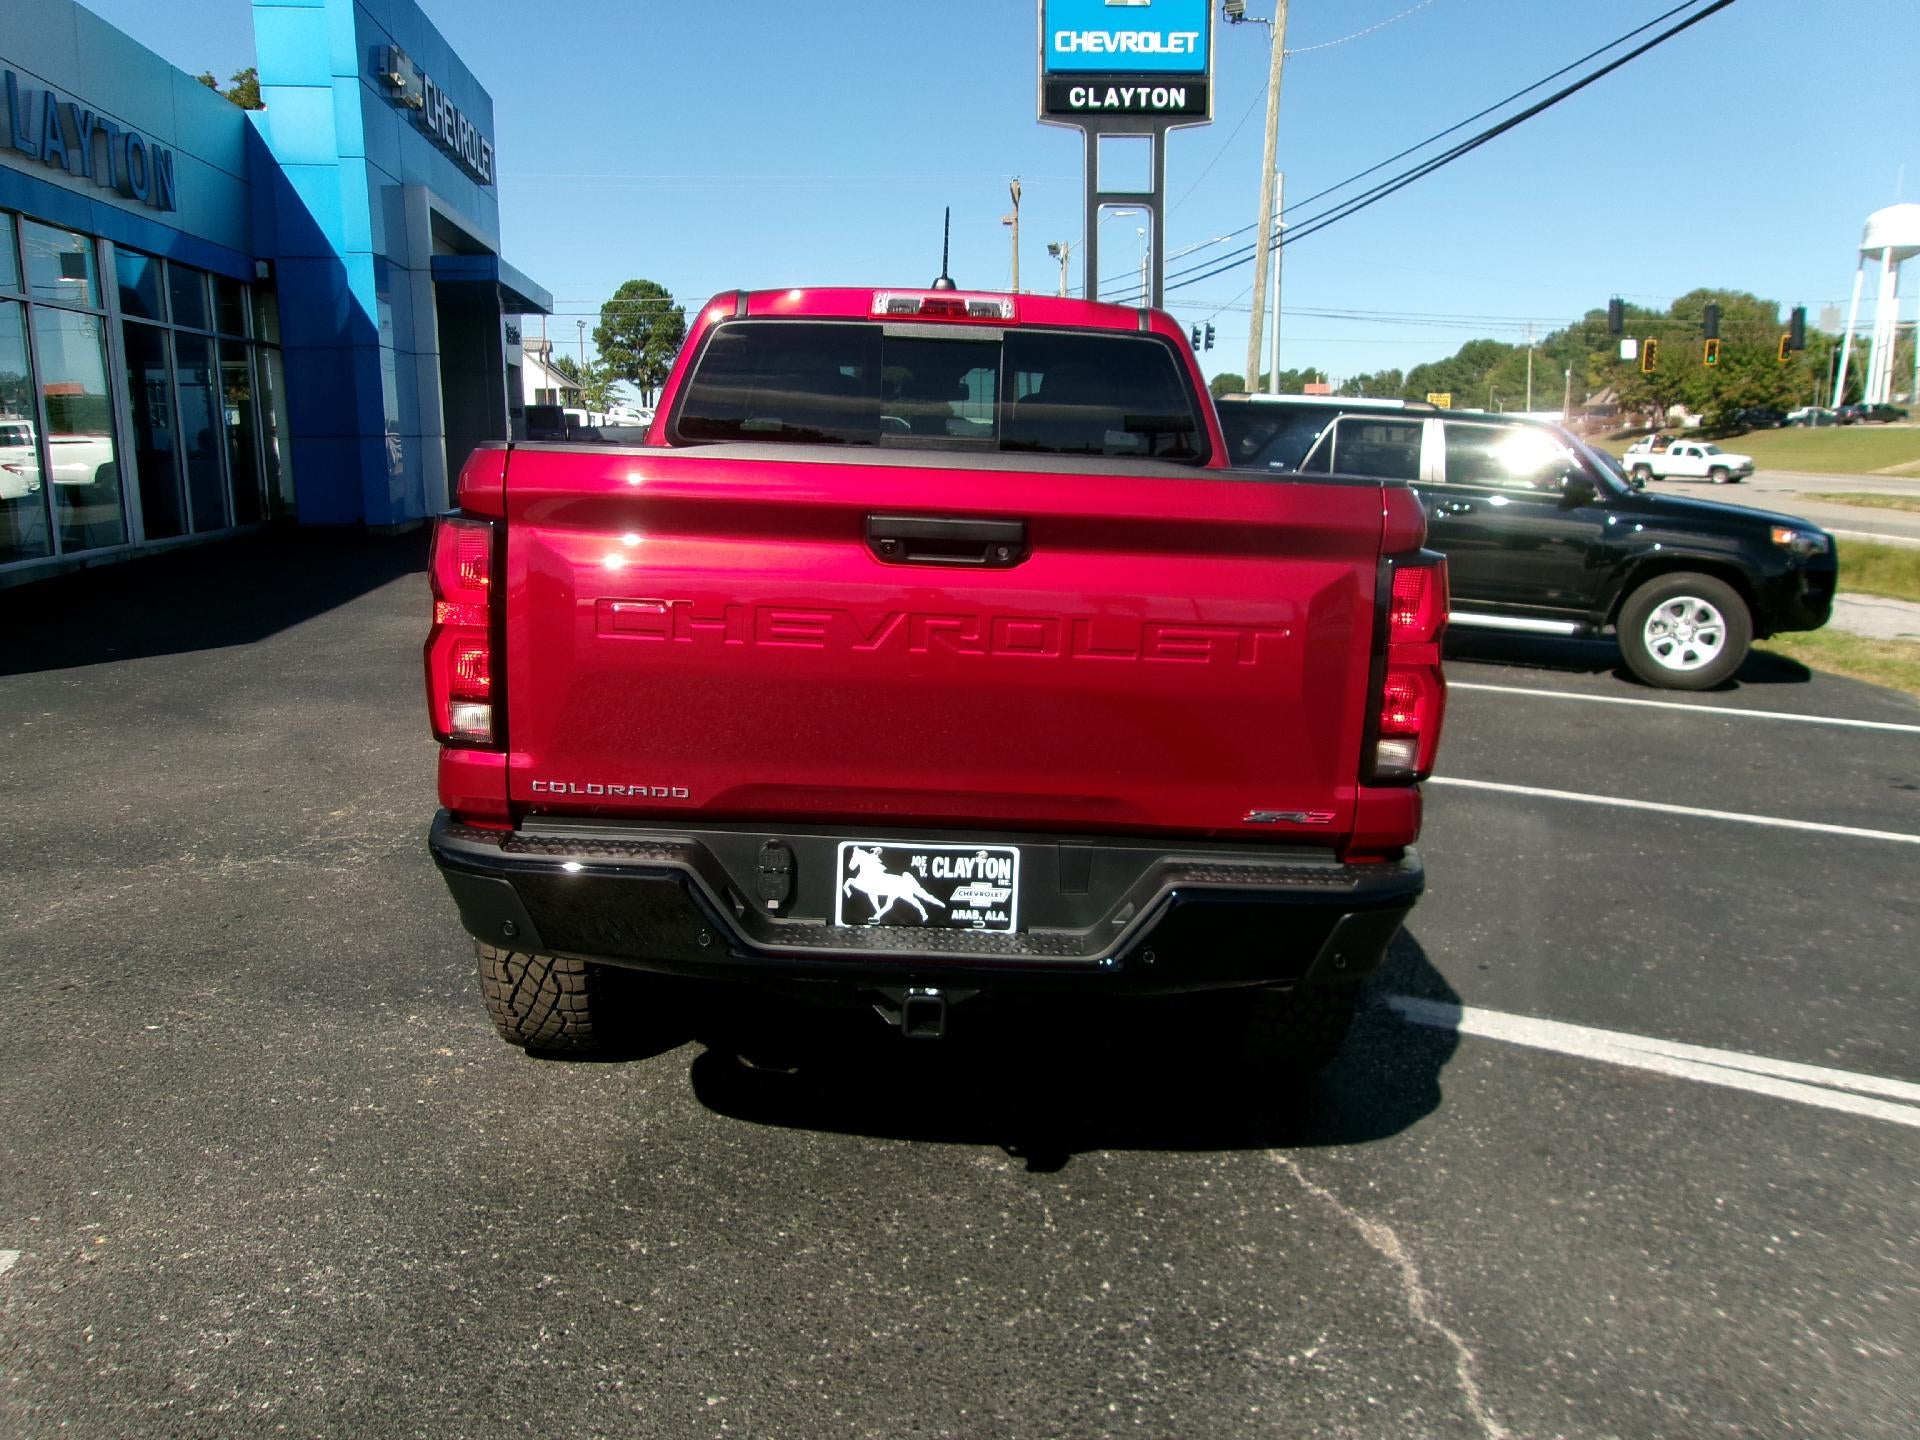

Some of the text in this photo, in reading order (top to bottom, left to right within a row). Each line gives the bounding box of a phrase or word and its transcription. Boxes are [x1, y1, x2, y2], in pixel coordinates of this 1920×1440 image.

[1054, 30, 1199, 53] CHEVROLET
[1069, 86, 1186, 108] CLAYTON
[424, 72, 494, 186] CHEVROLET
[4, 69, 177, 212] LAYTON
[594, 597, 1292, 665] CHEVROLET
[531, 779, 690, 799] COLORADO
[911, 855, 928, 867] JOE
[932, 856, 1011, 879] CLAYTON
[958, 890, 1004, 898] CHEVROLET
[985, 910, 1008, 921] ALA.
